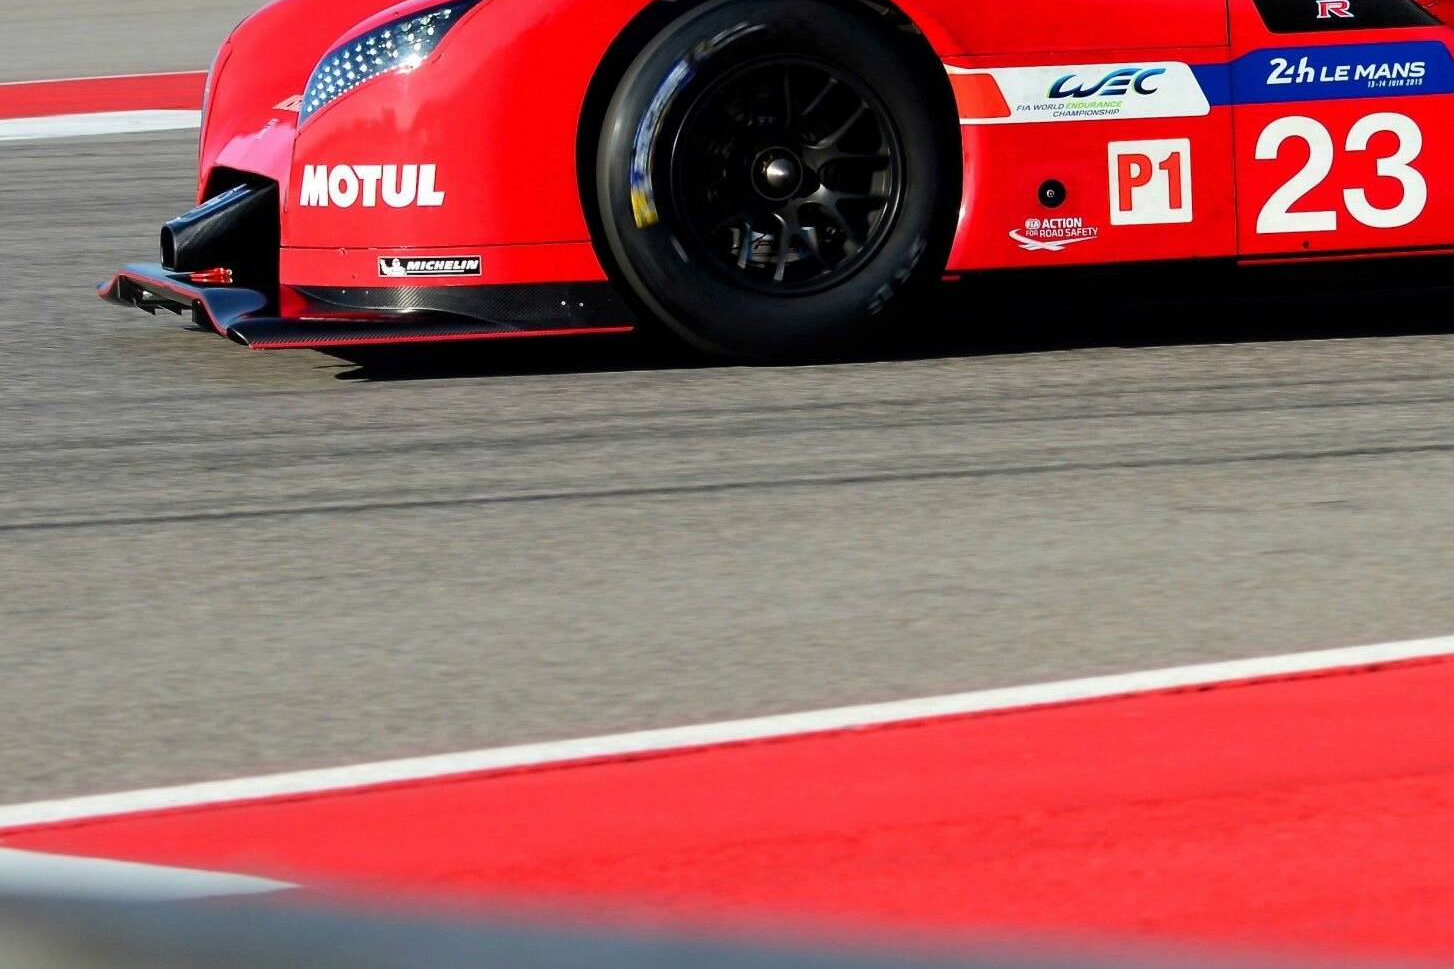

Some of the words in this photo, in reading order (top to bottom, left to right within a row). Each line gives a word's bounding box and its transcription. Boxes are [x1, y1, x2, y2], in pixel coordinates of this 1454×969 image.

[1316, 0, 1354, 18] R
[1266, 56, 1315, 85] 24h
[1320, 65, 1350, 82] LE
[1354, 62, 1425, 81] MANS
[1048, 67, 1166, 99] WEC
[1052, 108, 1120, 118] CHAMPIONSHIP
[1066, 100, 1123, 109] ENDURANCE
[1117, 151, 1182, 211] P1
[1254, 112, 1428, 234] 23
[299, 163, 446, 208] MOTUL
[1042, 218, 1082, 229] ACTION
[1040, 229, 1063, 238] ROAD
[1065, 228, 1098, 237] SAFETY
[407, 259, 480, 270] MICHELIN
